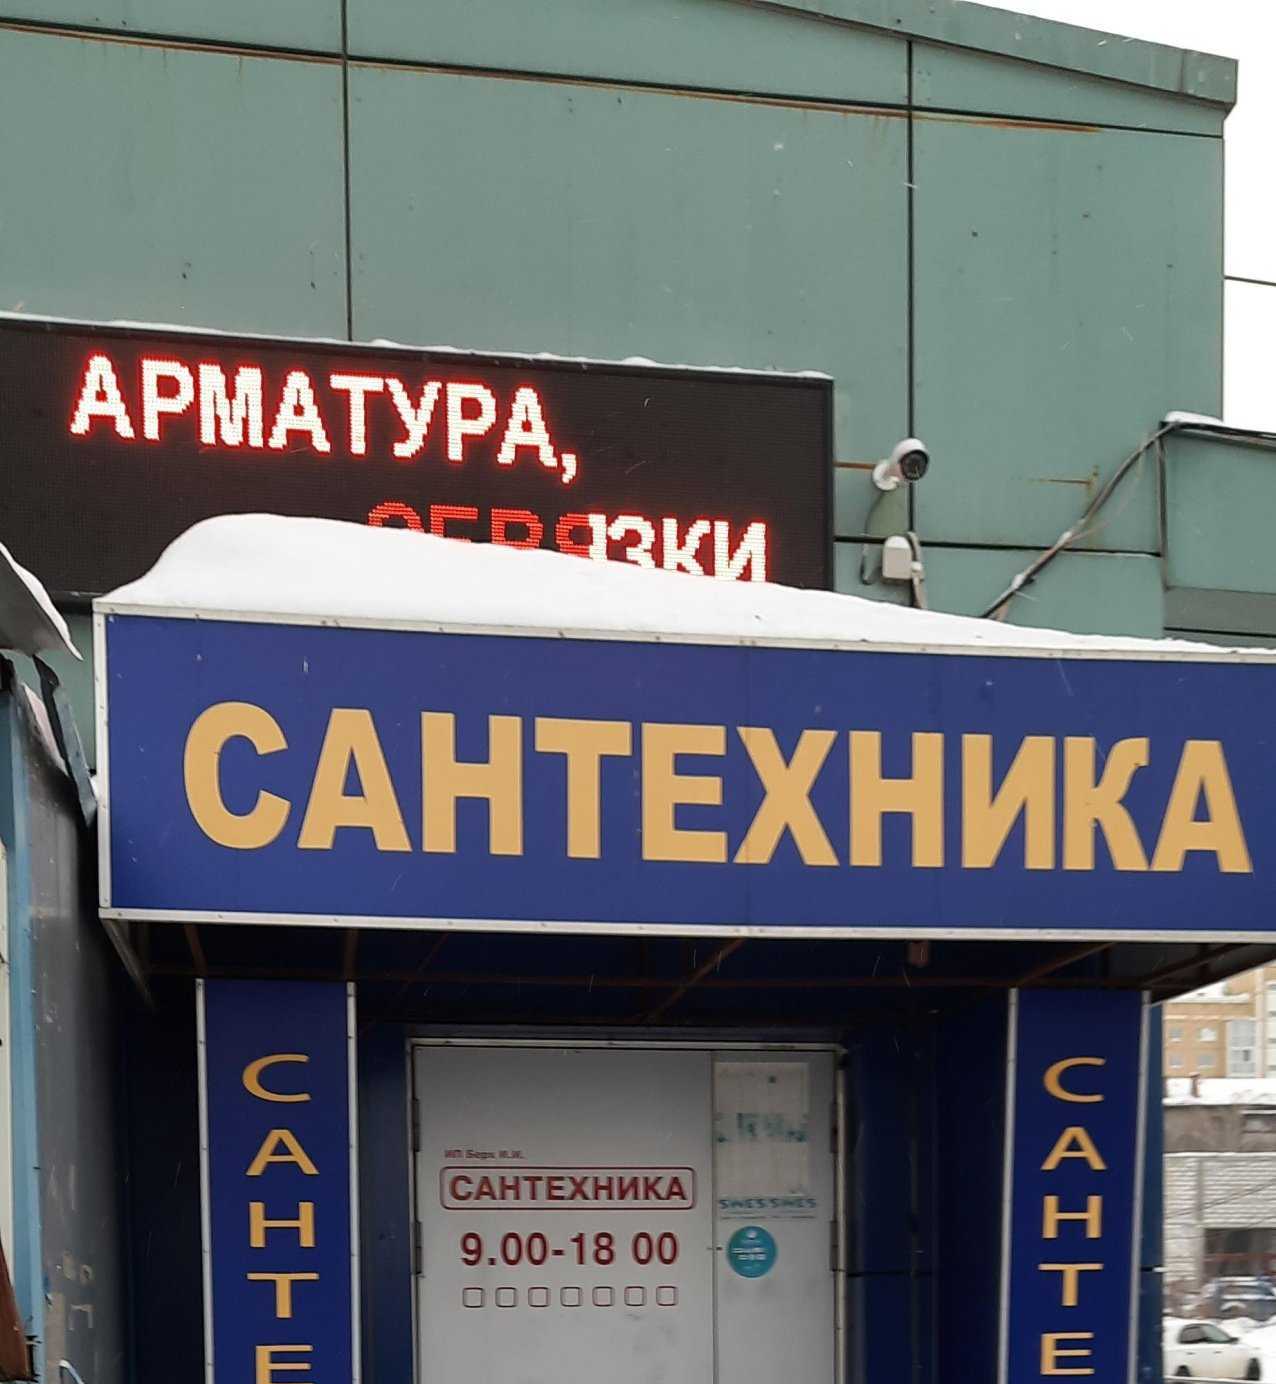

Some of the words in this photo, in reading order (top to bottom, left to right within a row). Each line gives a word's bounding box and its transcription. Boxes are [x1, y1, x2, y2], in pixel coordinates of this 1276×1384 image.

[70, 352, 579, 484] АРМАТУРА,
[184, 702, 1253, 873] САНТЕХНИКА
[449, 1175, 688, 1202] САНТЕХНИКА
[461, 1231, 615, 1267] 9.00-18
[632, 1231, 679, 1266] 00
